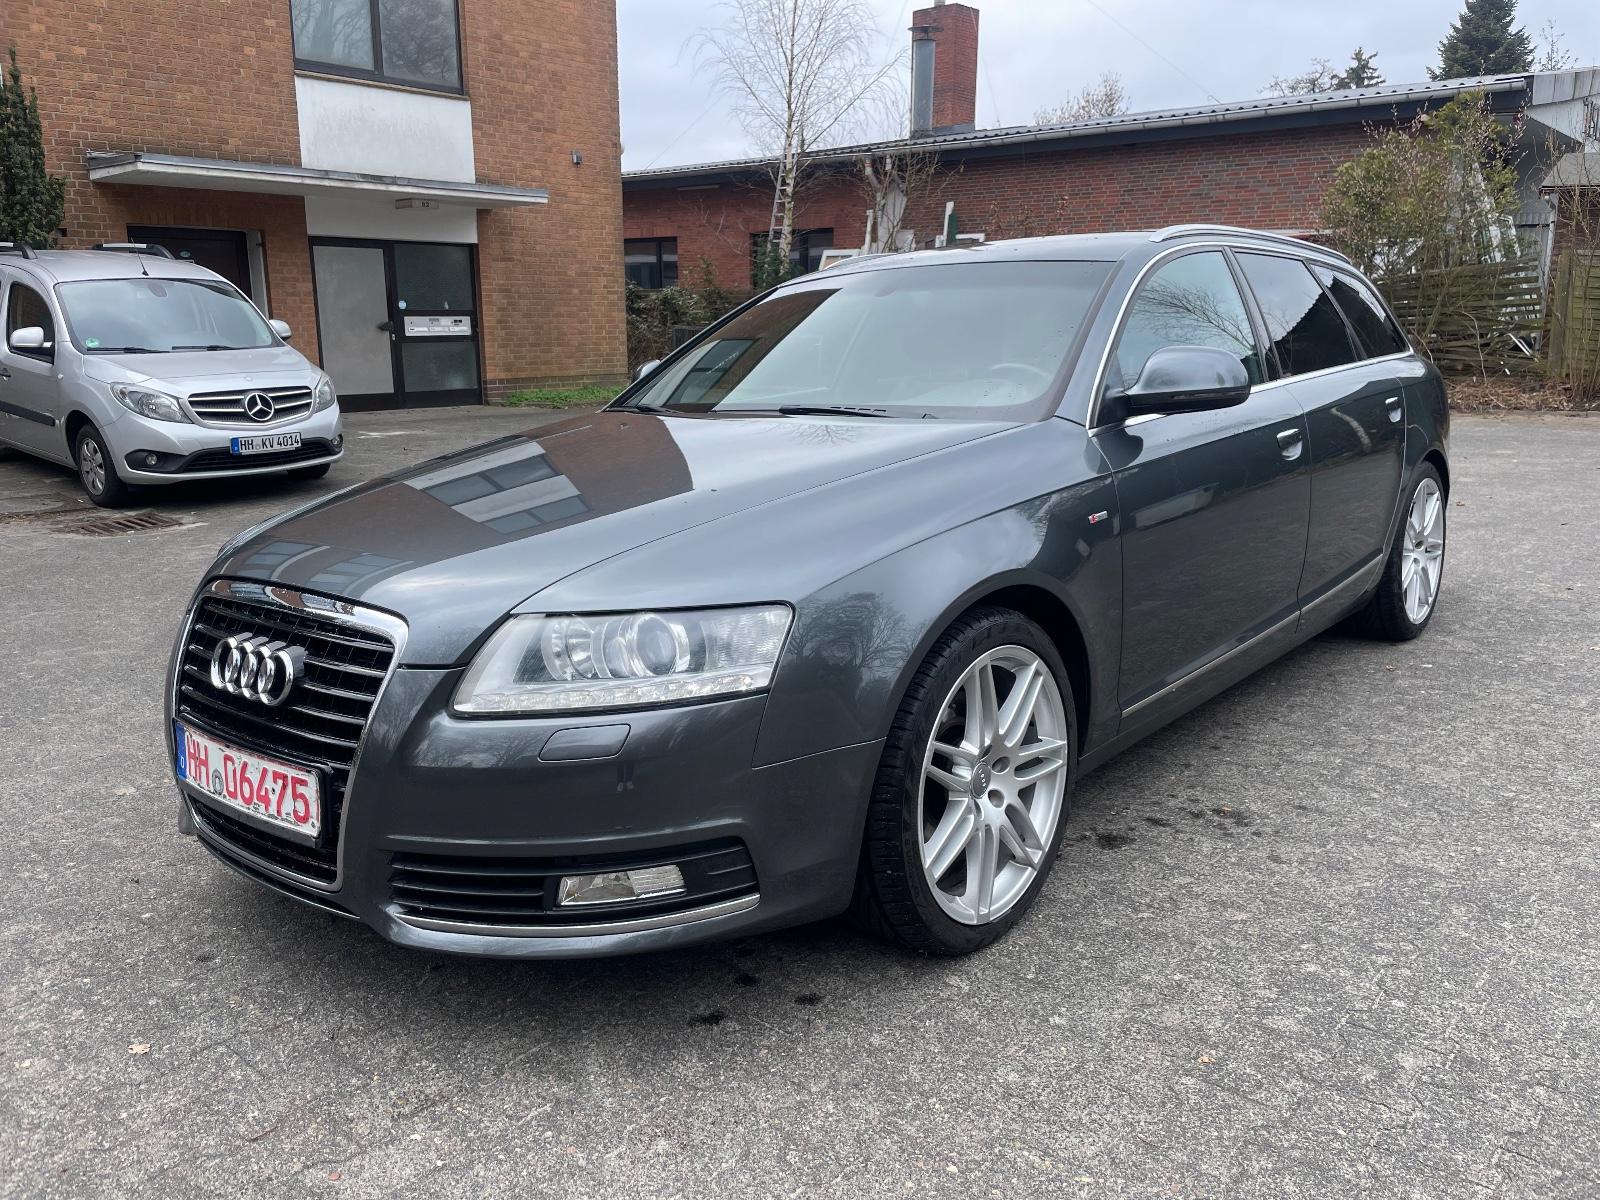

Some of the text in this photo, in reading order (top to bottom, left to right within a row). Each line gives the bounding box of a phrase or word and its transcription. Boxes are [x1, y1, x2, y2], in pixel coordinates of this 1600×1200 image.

[240, 439, 254, 451] HH
[261, 438, 274, 449] KV
[277, 435, 300, 447] 4014
[186, 734, 311, 824] HH 06475
